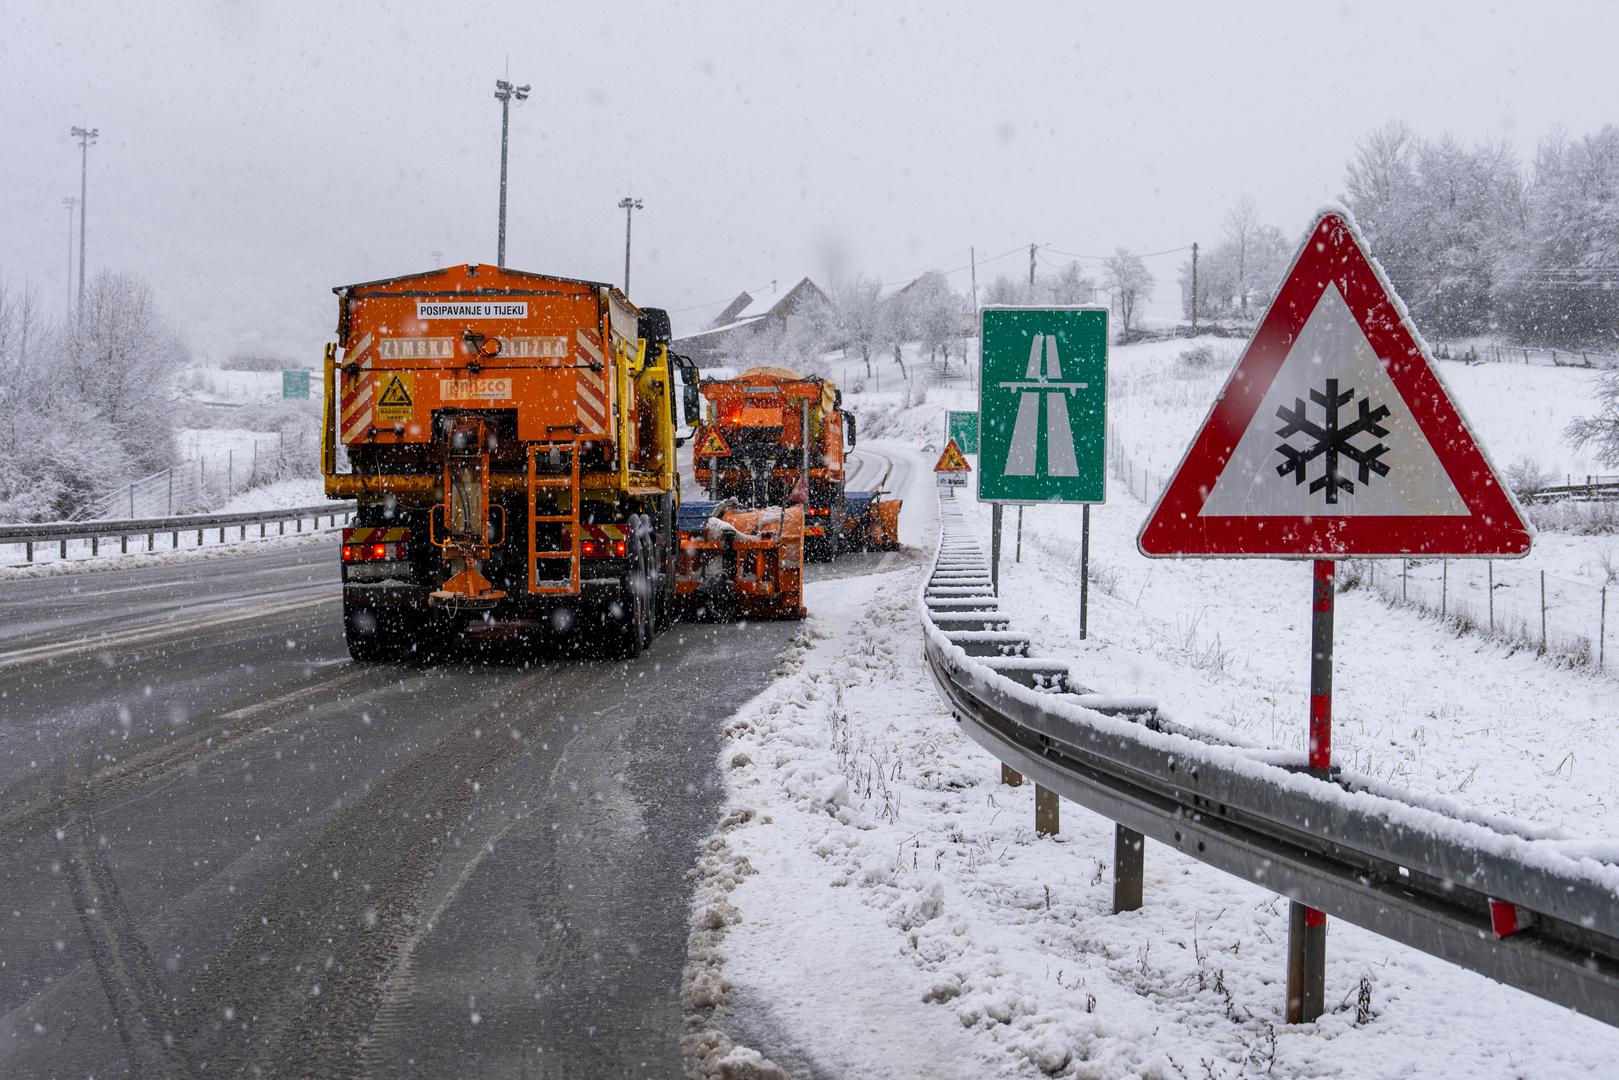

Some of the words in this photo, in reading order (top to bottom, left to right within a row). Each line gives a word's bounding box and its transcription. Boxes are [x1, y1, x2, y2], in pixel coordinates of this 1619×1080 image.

[420, 305, 482, 316] POSIPAVANJE
[484, 305, 491, 315] U
[493, 305, 524, 315] TIJEKU
[383, 340, 450, 356] ZIMSKA
